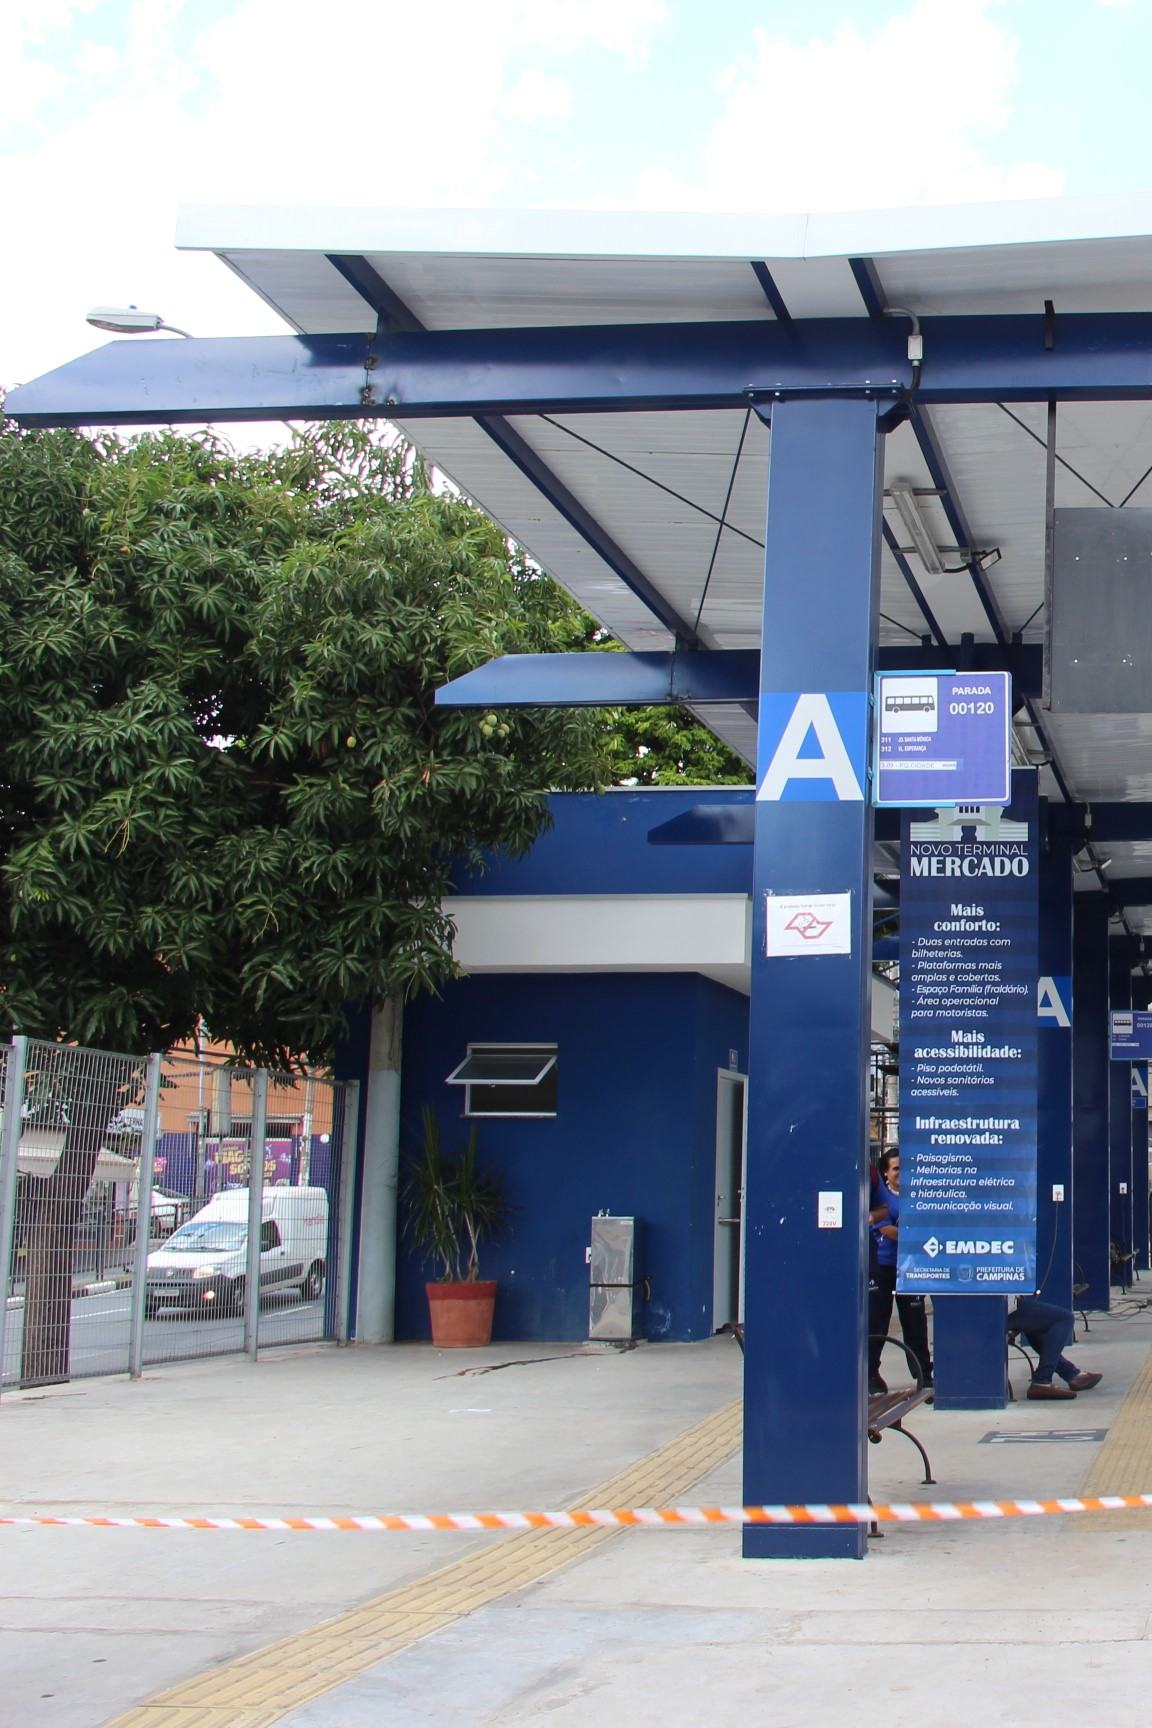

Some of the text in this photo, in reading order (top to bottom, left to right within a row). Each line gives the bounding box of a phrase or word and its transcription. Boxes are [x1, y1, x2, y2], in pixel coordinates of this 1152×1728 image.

[952, 686, 991, 696] PARADA
[949, 702, 994, 715] 00120
[756, 693, 864, 801] A
[881, 745, 892, 753] 312
[905, 745, 926, 753] ESPERANÇA
[911, 844, 1028, 856] NOVO TERMINAL
[911, 857, 1029, 878] MERCADO
[951, 904, 984, 916] Mais
[934, 919, 1000, 932] conforto:
[918, 938, 943, 947] Duas
[945, 938, 988, 947] entradas
[990, 939, 1011, 947] com
[911, 949, 964, 958] bilheterias.
[918, 961, 976, 970] Plataformas
[979, 961, 1003, 970] mais
[911, 973, 947, 983] amplas
[957, 973, 1001, 982] cobertas.
[917, 985, 949, 995] Espaço
[950, 984, 982, 994] Família
[984, 984, 1029, 996] (fraldário).
[917, 995, 939, 1006] Área
[942, 996, 999, 1007] operacional
[1037, 976, 1071, 1027] A
[911, 1008, 988, 1019] para motoristas.
[951, 1030, 985, 1043] Mais
[914, 1045, 1021, 1058] acessibilidade:
[917, 1063, 936, 1073] Piso
[938, 1063, 983, 1075] podotátil.
[917, 1075, 945, 1084] Novos
[947, 1075, 994, 1084] sanitários
[1131, 1068, 1148, 1096] A
[911, 1087, 959, 1096] acessíveis.
[916, 1116, 1020, 1129] Infraestrutura
[931, 1132, 1003, 1145] renovada:
[917, 1153, 973, 1164] Paisagismo.
[917, 1164, 963, 1174] Melhorias
[911, 1176, 1015, 1186] infraestrutura elétrica
[918, 1188, 968, 1198] hidráulica.
[916, 1201, 981, 1212] Comunicação
[984, 1201, 1013, 1210] visual.
[946, 1241, 1014, 1254] EMDEC
[906, 1272, 951, 1280] TRANSPORTES
[976, 1273, 1025, 1281] CAMPINAS
